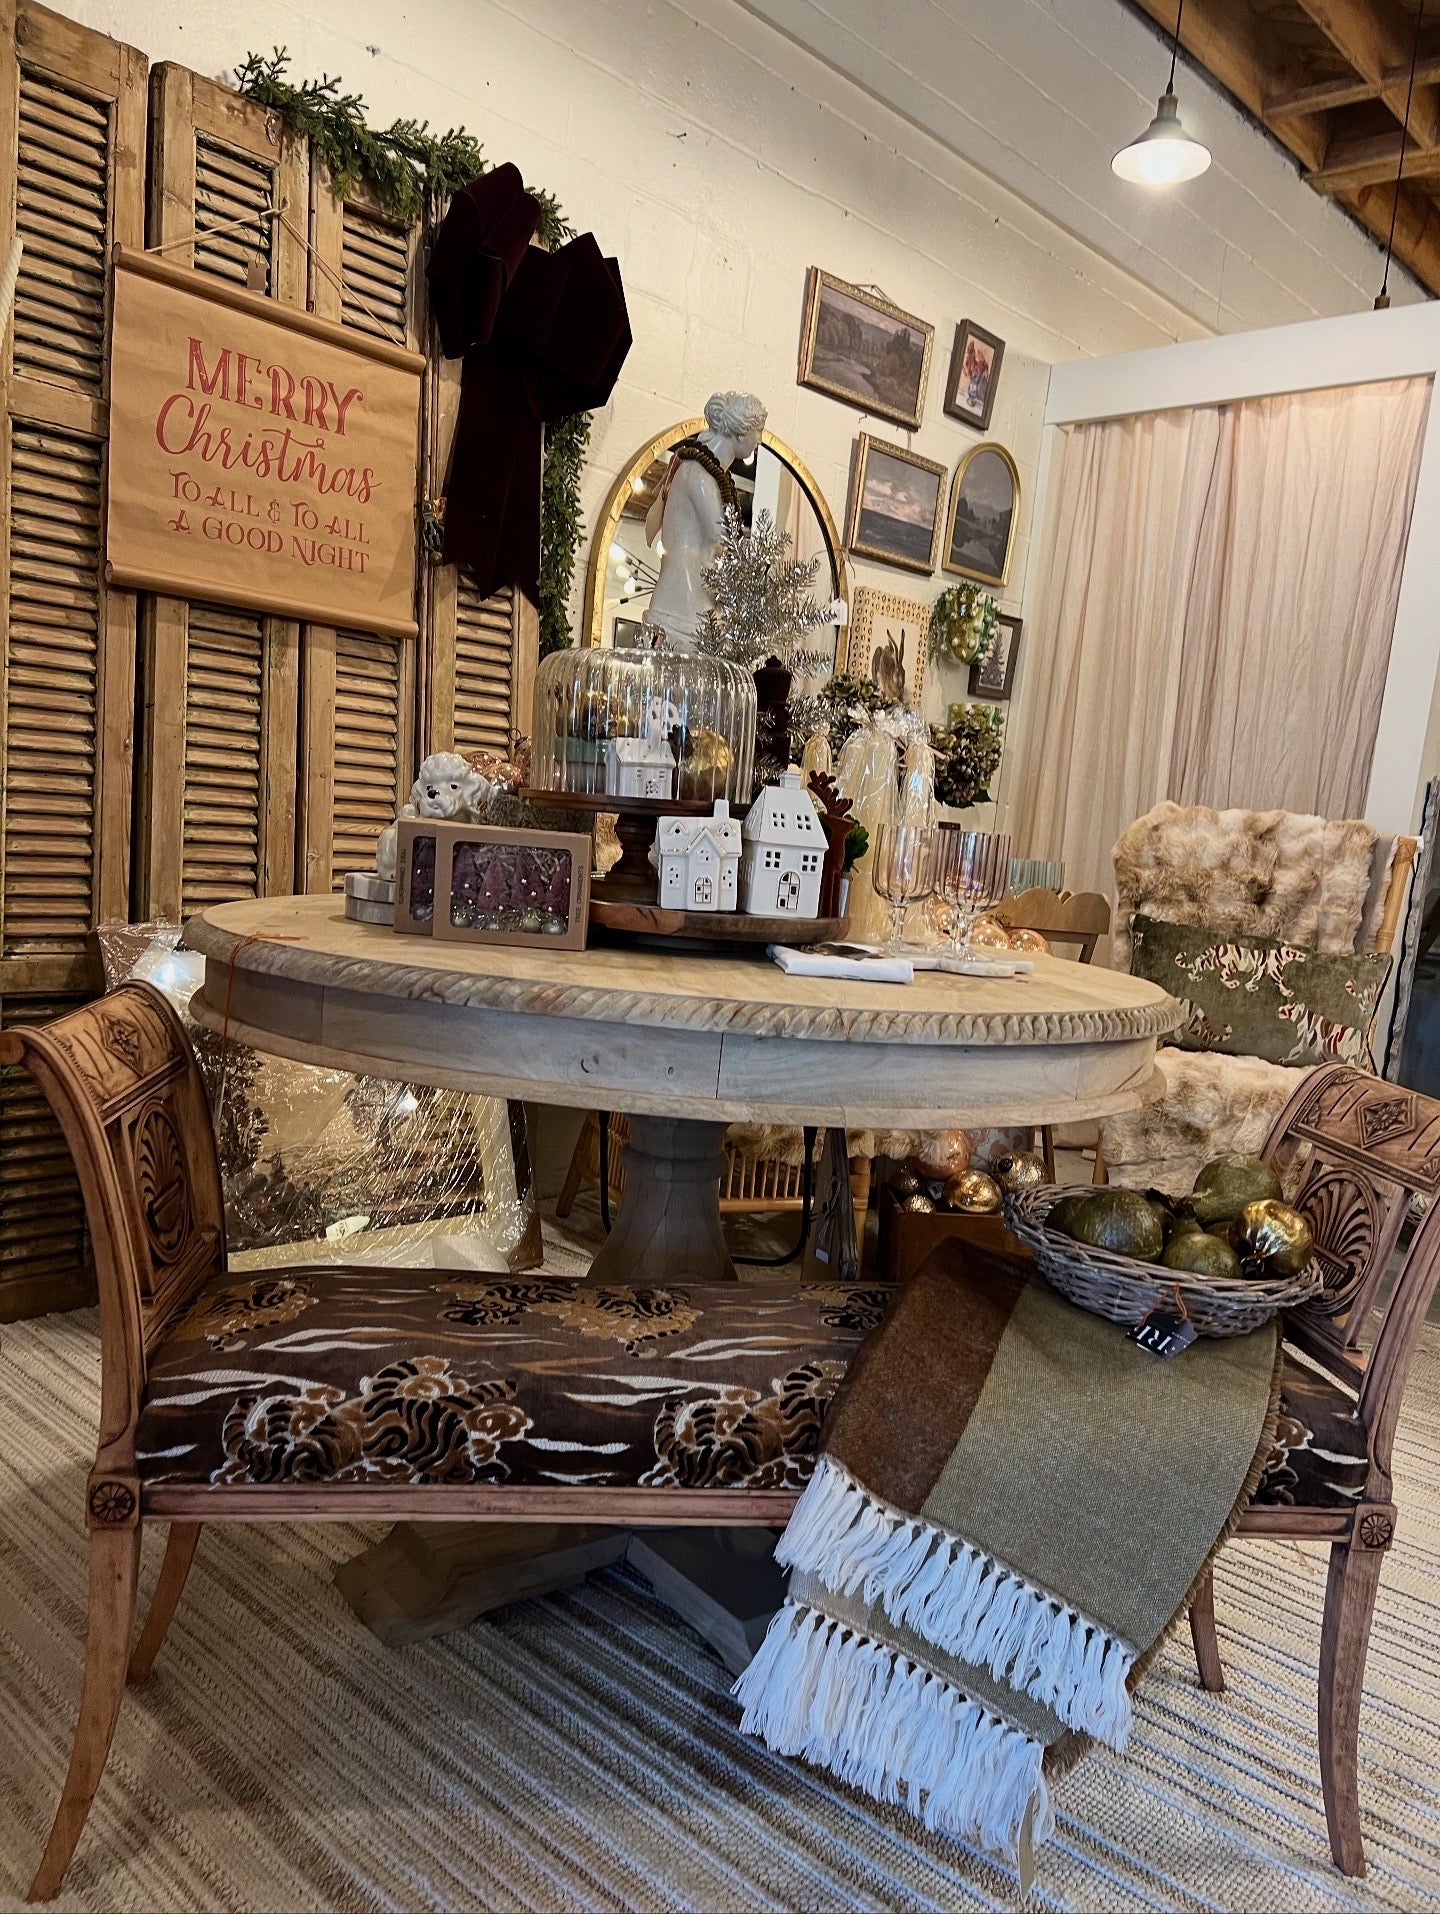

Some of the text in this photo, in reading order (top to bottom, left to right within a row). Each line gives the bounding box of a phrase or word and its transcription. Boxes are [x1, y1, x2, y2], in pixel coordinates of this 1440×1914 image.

[186, 337, 363, 436] MERRY
[155, 394, 382, 503] Christmas
[168, 509, 370, 573] A GOOD NIGHT
[205, 486, 260, 518] ALL
[267, 498, 281, 524] &
[324, 516, 370, 544] ALL
[398, 867, 406, 905] ORNAMENTS
[576, 865, 584, 904] ORNAMENTS
